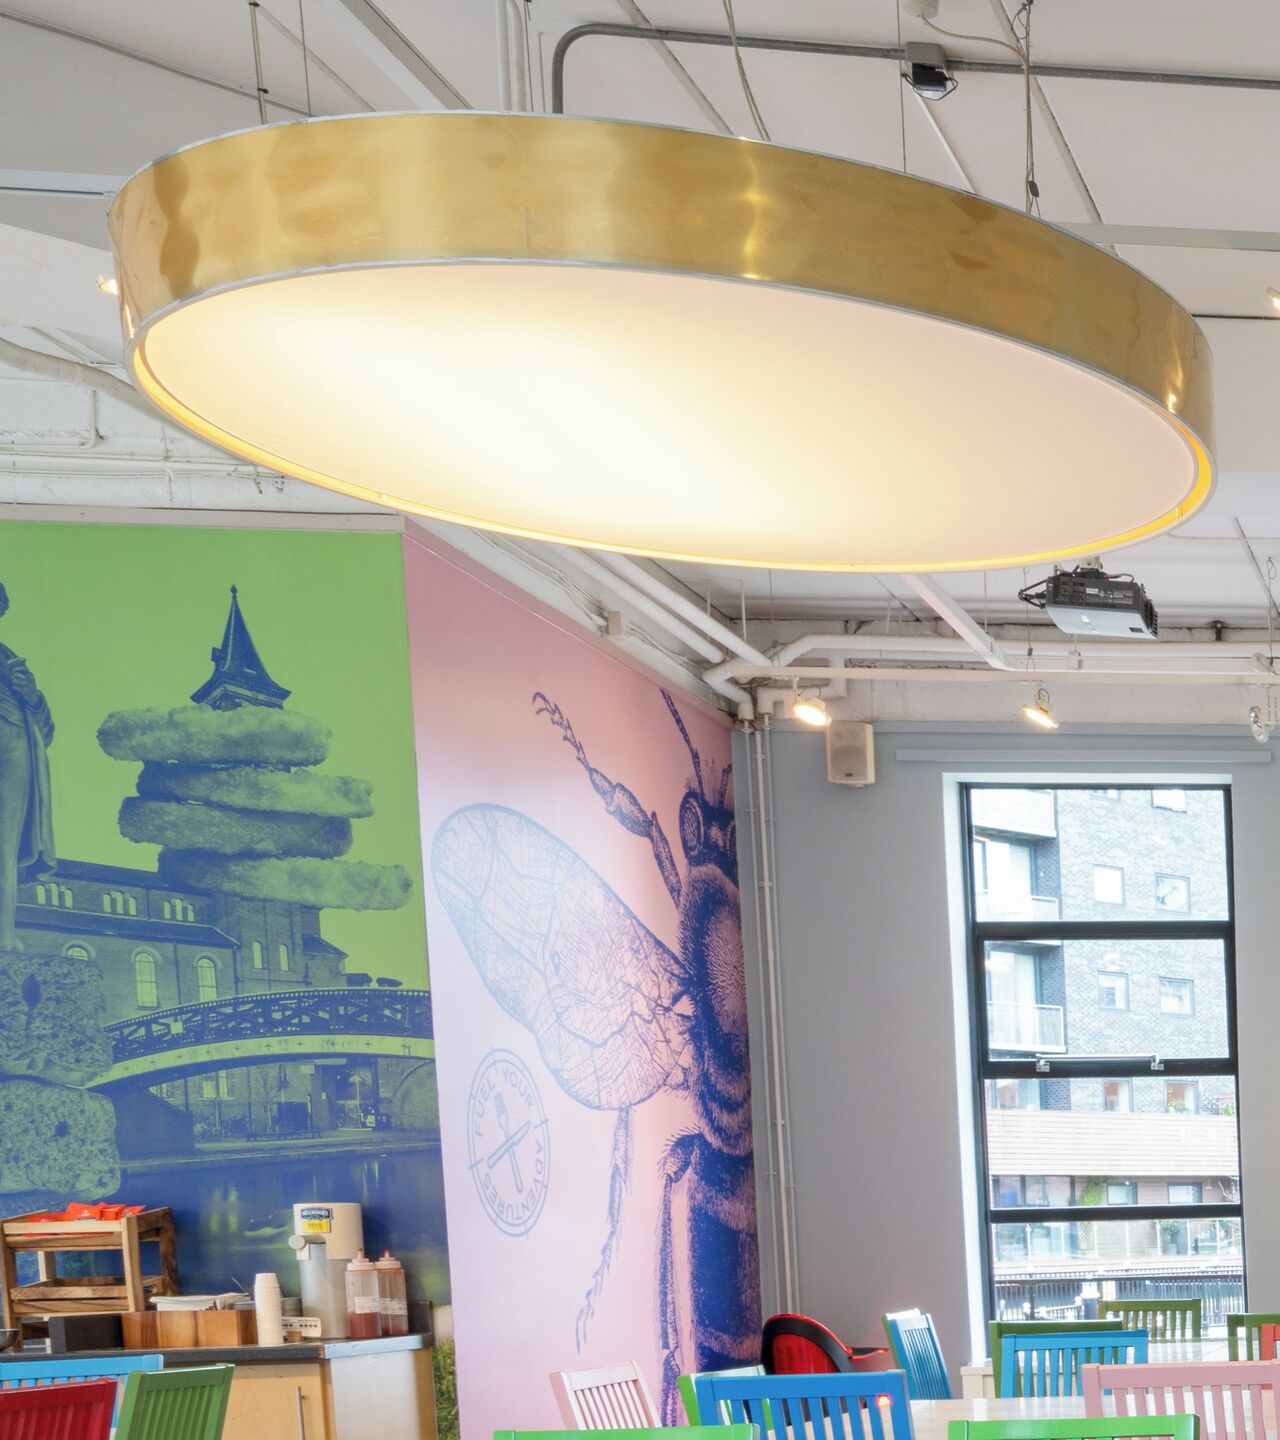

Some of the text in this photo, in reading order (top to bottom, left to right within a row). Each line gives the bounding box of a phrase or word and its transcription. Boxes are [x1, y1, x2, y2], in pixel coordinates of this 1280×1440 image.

[475, 1066, 544, 1221] FUEL YOUR ADVENTURES
